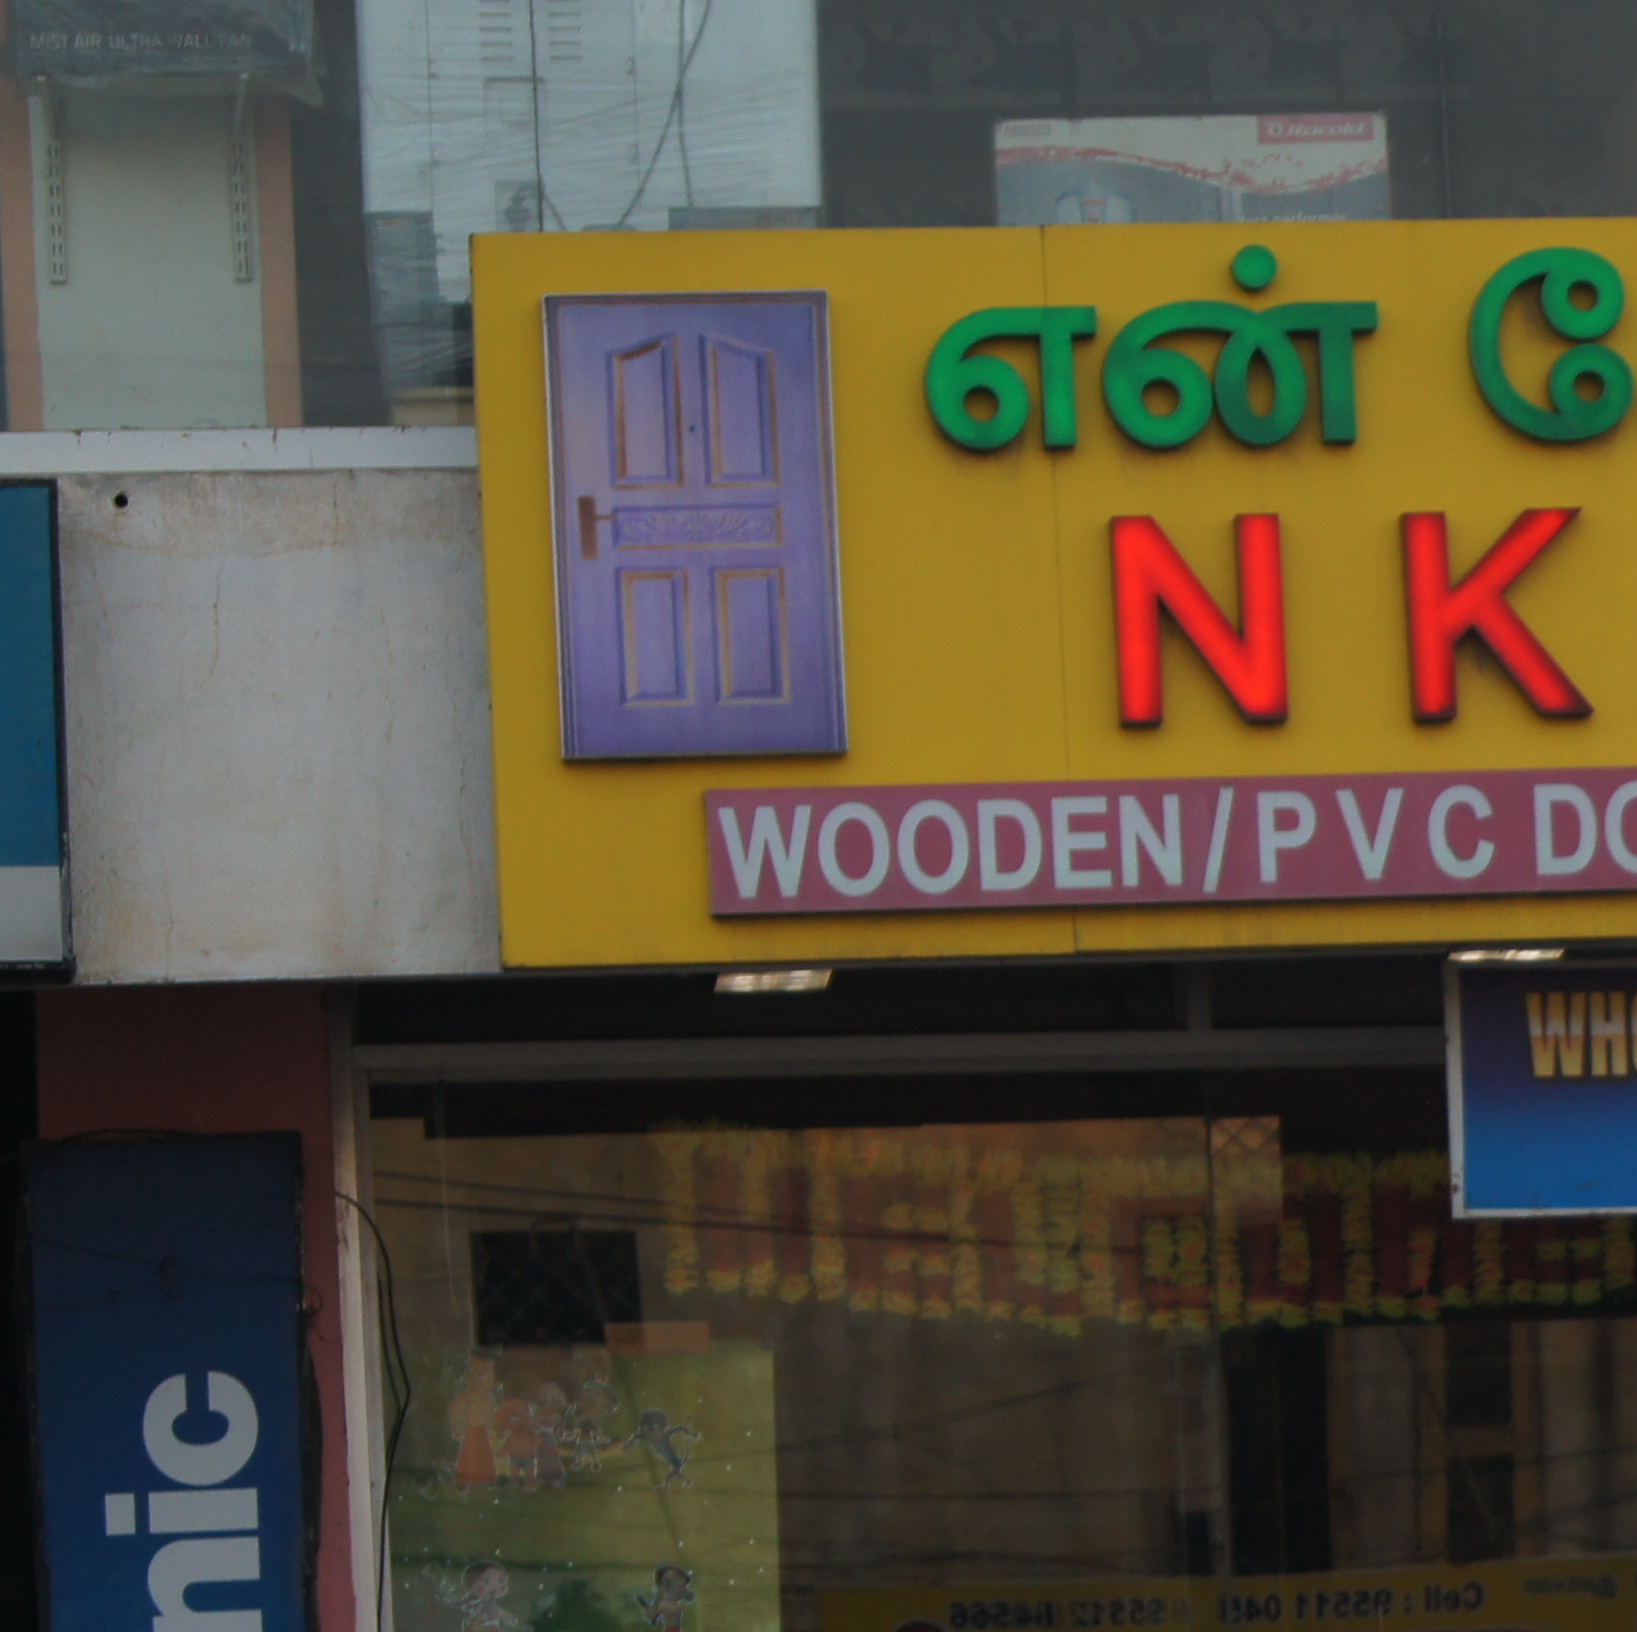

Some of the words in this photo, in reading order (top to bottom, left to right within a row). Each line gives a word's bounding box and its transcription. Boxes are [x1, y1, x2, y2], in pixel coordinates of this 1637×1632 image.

[74, 32, 101, 50] AIR
[108, 33, 163, 51] ULTRA
[1285, 120, 1366, 138] Racold
[922, 244, 1378, 454] என்
[1107, 511, 1289, 729] N
[1400, 506, 1594, 724] K
